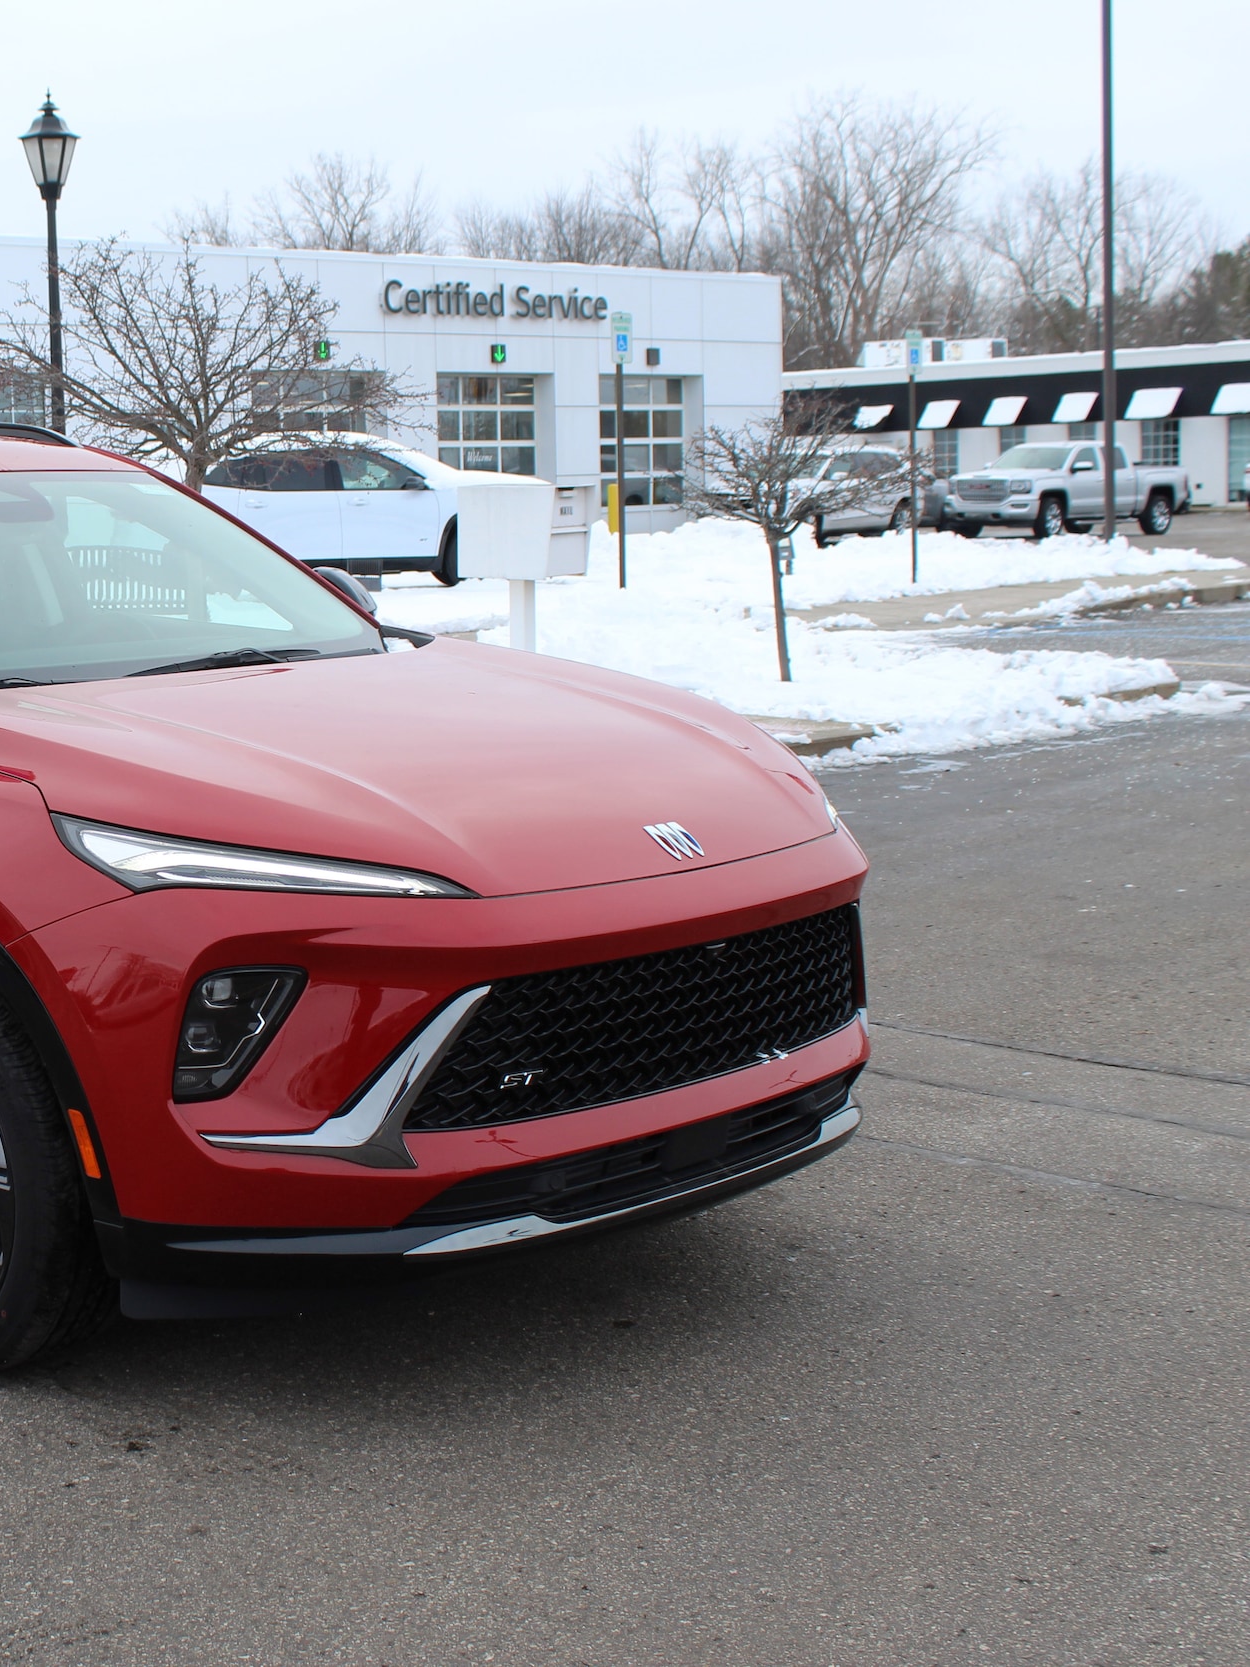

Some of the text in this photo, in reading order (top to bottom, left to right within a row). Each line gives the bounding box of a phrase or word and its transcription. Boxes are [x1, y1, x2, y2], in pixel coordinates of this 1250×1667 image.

[383, 278, 608, 320] Certified Service
[499, 1069, 544, 1090] ST
